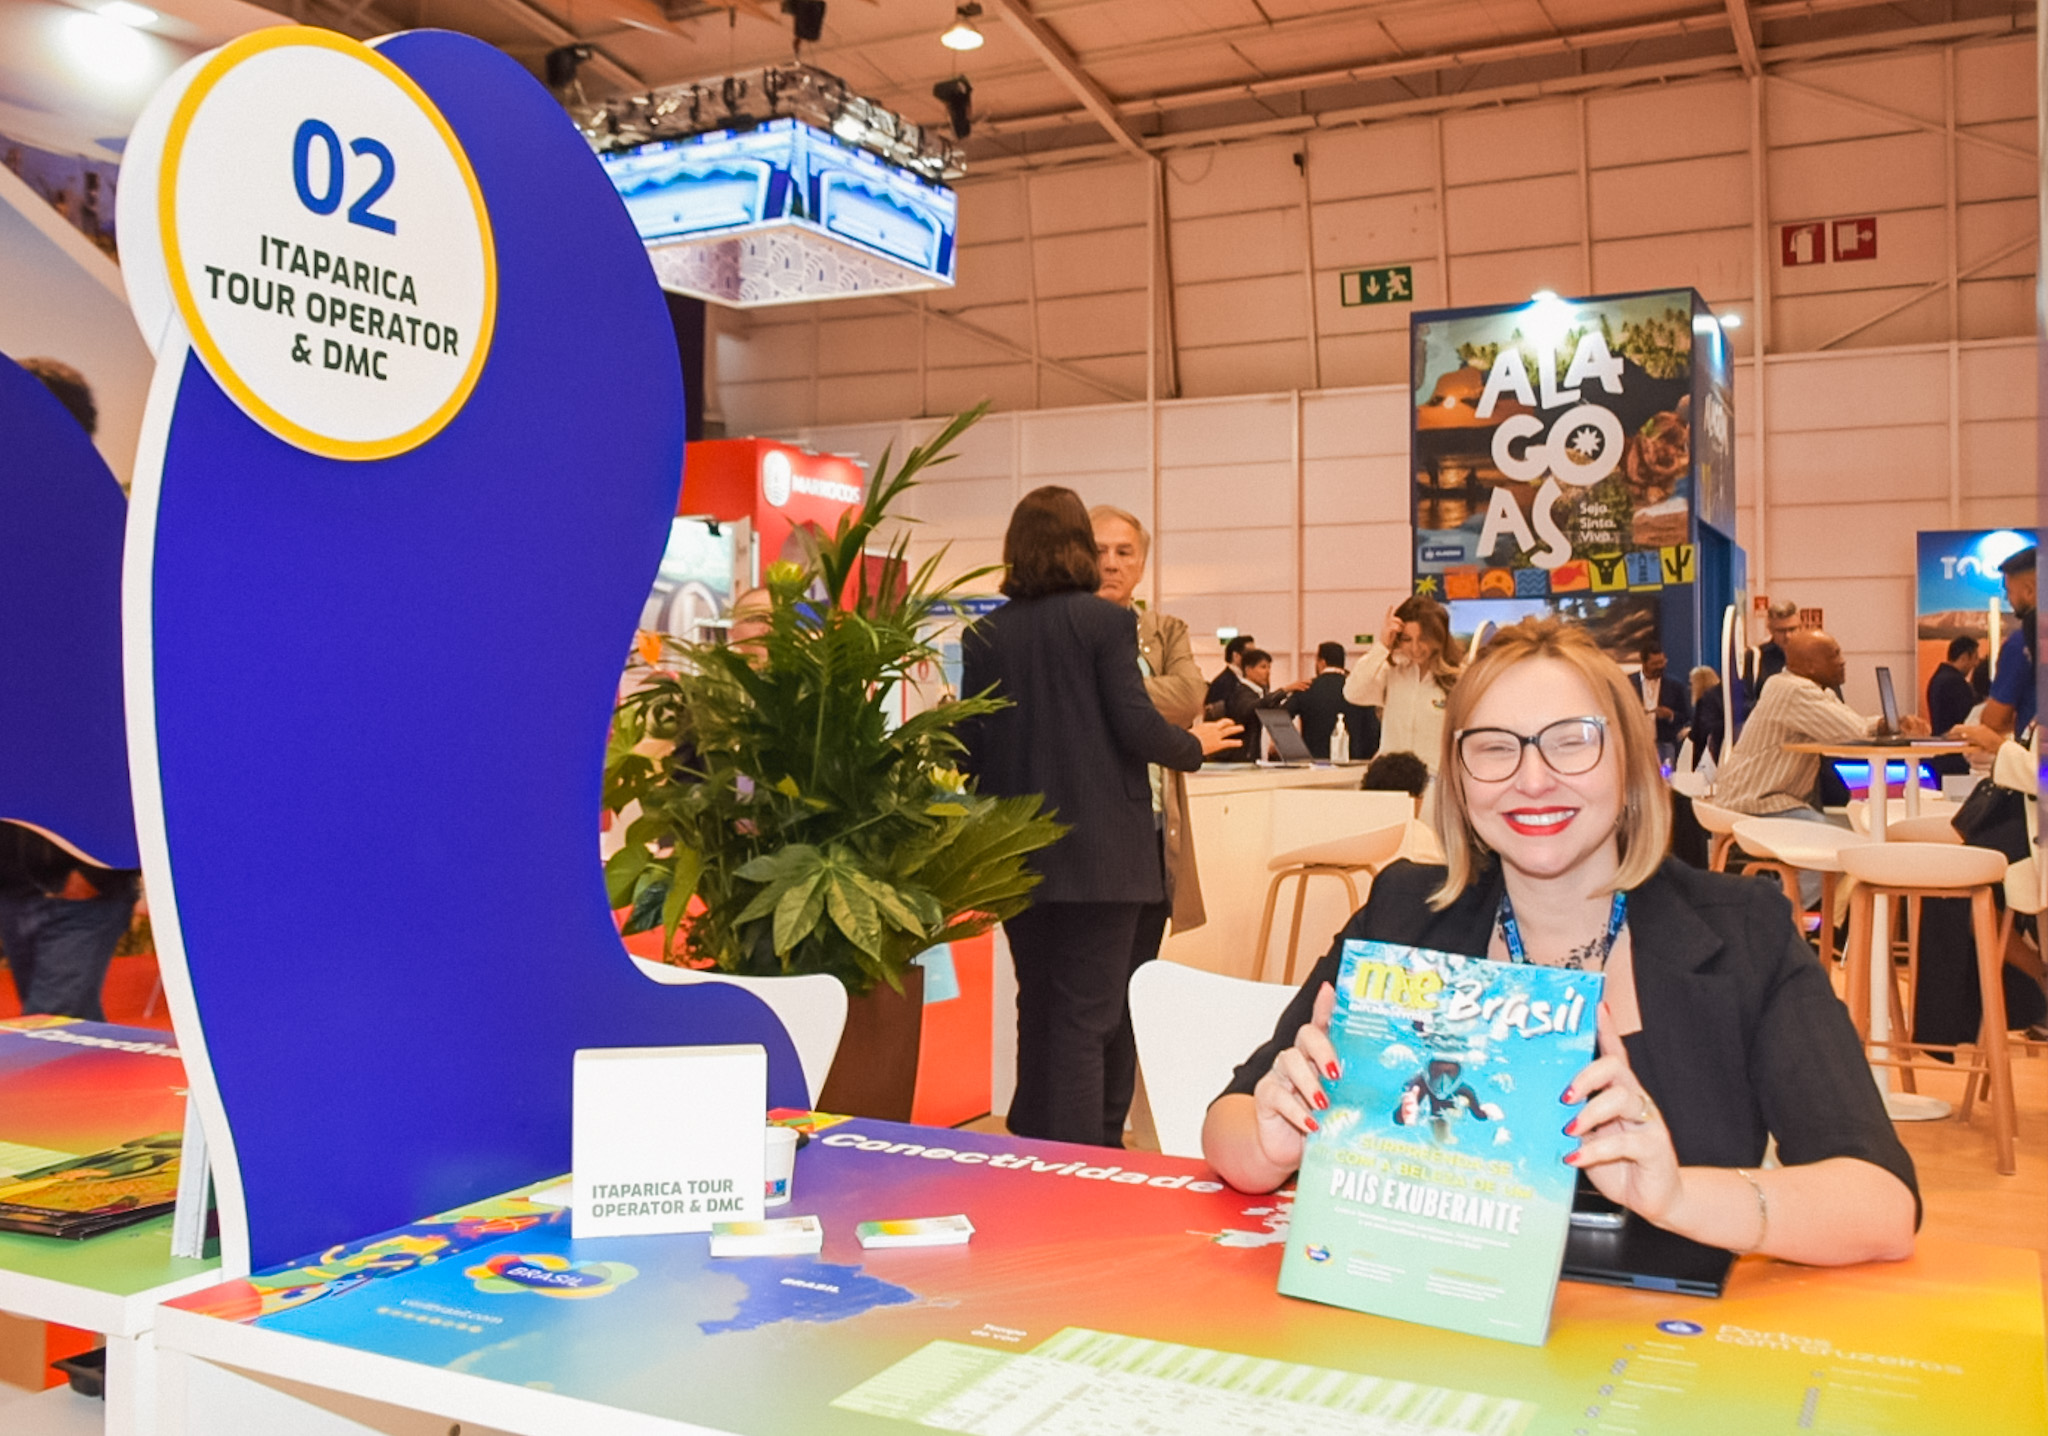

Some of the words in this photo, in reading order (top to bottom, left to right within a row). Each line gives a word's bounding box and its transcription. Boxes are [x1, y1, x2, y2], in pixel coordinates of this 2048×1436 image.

[292, 118, 397, 236] 02
[260, 234, 418, 306] ITAPARICA
[205, 265, 295, 318] TOUR
[306, 292, 459, 356] OPERATOR
[291, 333, 312, 366] &
[323, 340, 388, 381] DMC
[1446, 980, 1585, 1039] Brasil
[592, 1181, 682, 1199] ITAPARICA
[687, 1179, 733, 1195] TOUR
[822, 1133, 1224, 1193] Conectividade
[592, 1201, 684, 1218] OPERATOR
[689, 1199, 701, 1213] &
[707, 1197, 744, 1213] DMC
[1329, 1167, 1379, 1206] PAÍS
[1381, 1178, 1524, 1235] EXUBERANTE
[507, 1266, 584, 1288] BRASIL
